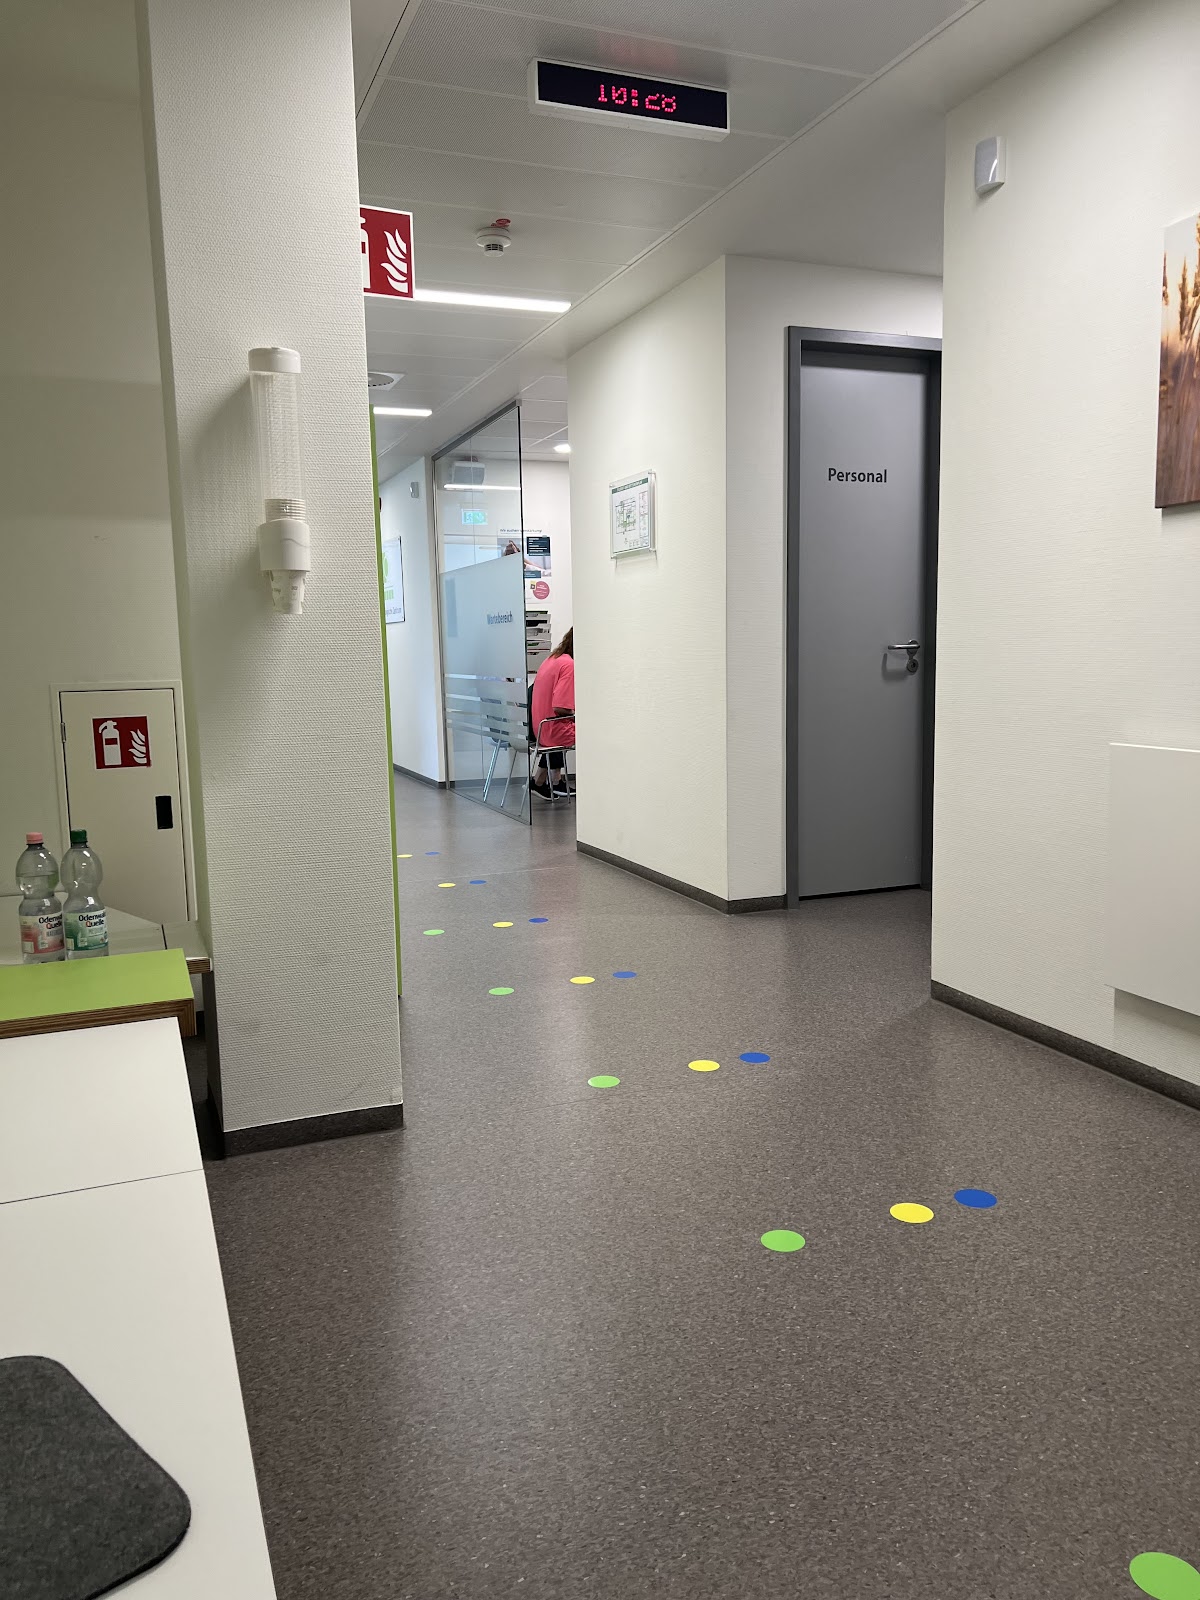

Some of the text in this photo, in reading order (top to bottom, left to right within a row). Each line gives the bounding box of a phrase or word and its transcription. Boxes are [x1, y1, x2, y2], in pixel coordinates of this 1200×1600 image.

[598, 84, 677, 113] 10:28
[828, 467, 888, 484] Personal
[486, 610, 514, 625] Wartebereich
[85, 918, 105, 928] Quelle
